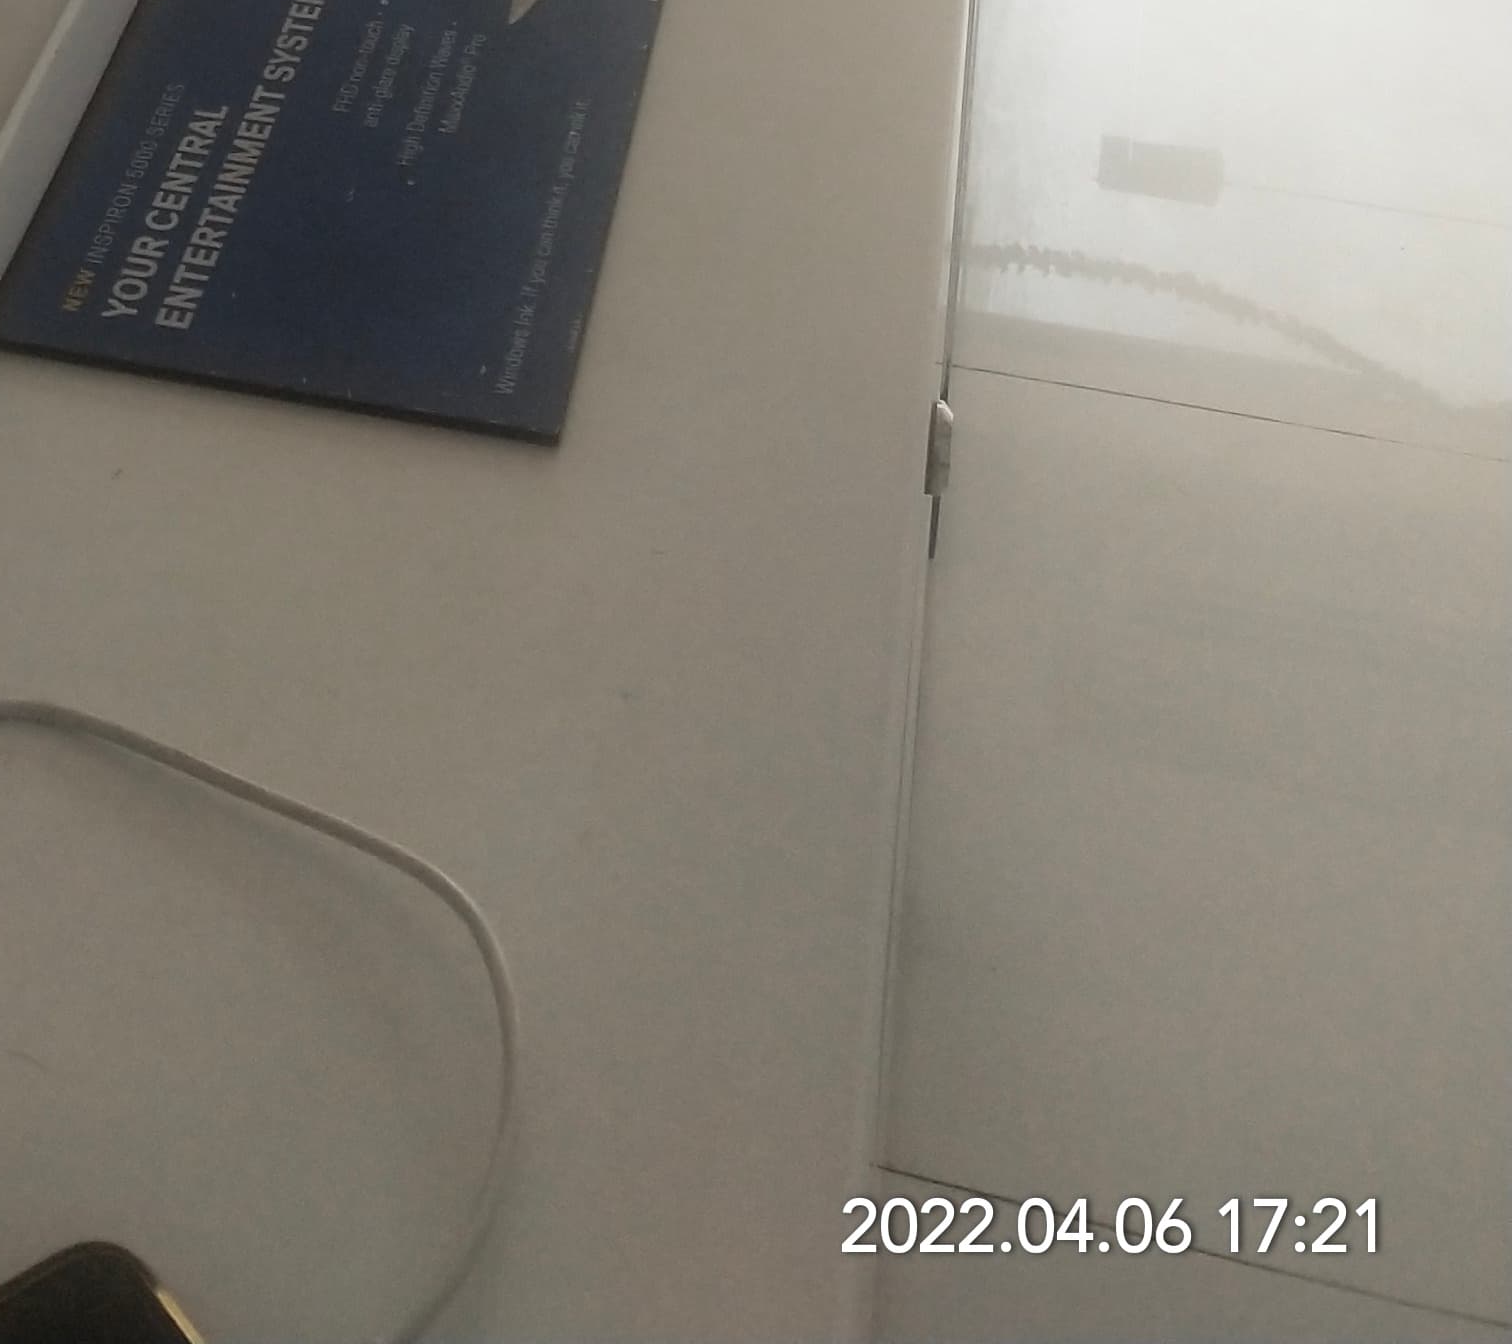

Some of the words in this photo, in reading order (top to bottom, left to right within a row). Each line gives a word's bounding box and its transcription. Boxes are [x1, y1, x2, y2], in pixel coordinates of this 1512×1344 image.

[58, 265, 97, 312] NEW
[87, 184, 138, 266] INSPIRON
[145, 80, 186, 137] SERIES
[101, 234, 170, 317] YOUR
[144, 105, 230, 232] CENTRAL
[154, 84, 288, 331] ENTERTAINMENT
